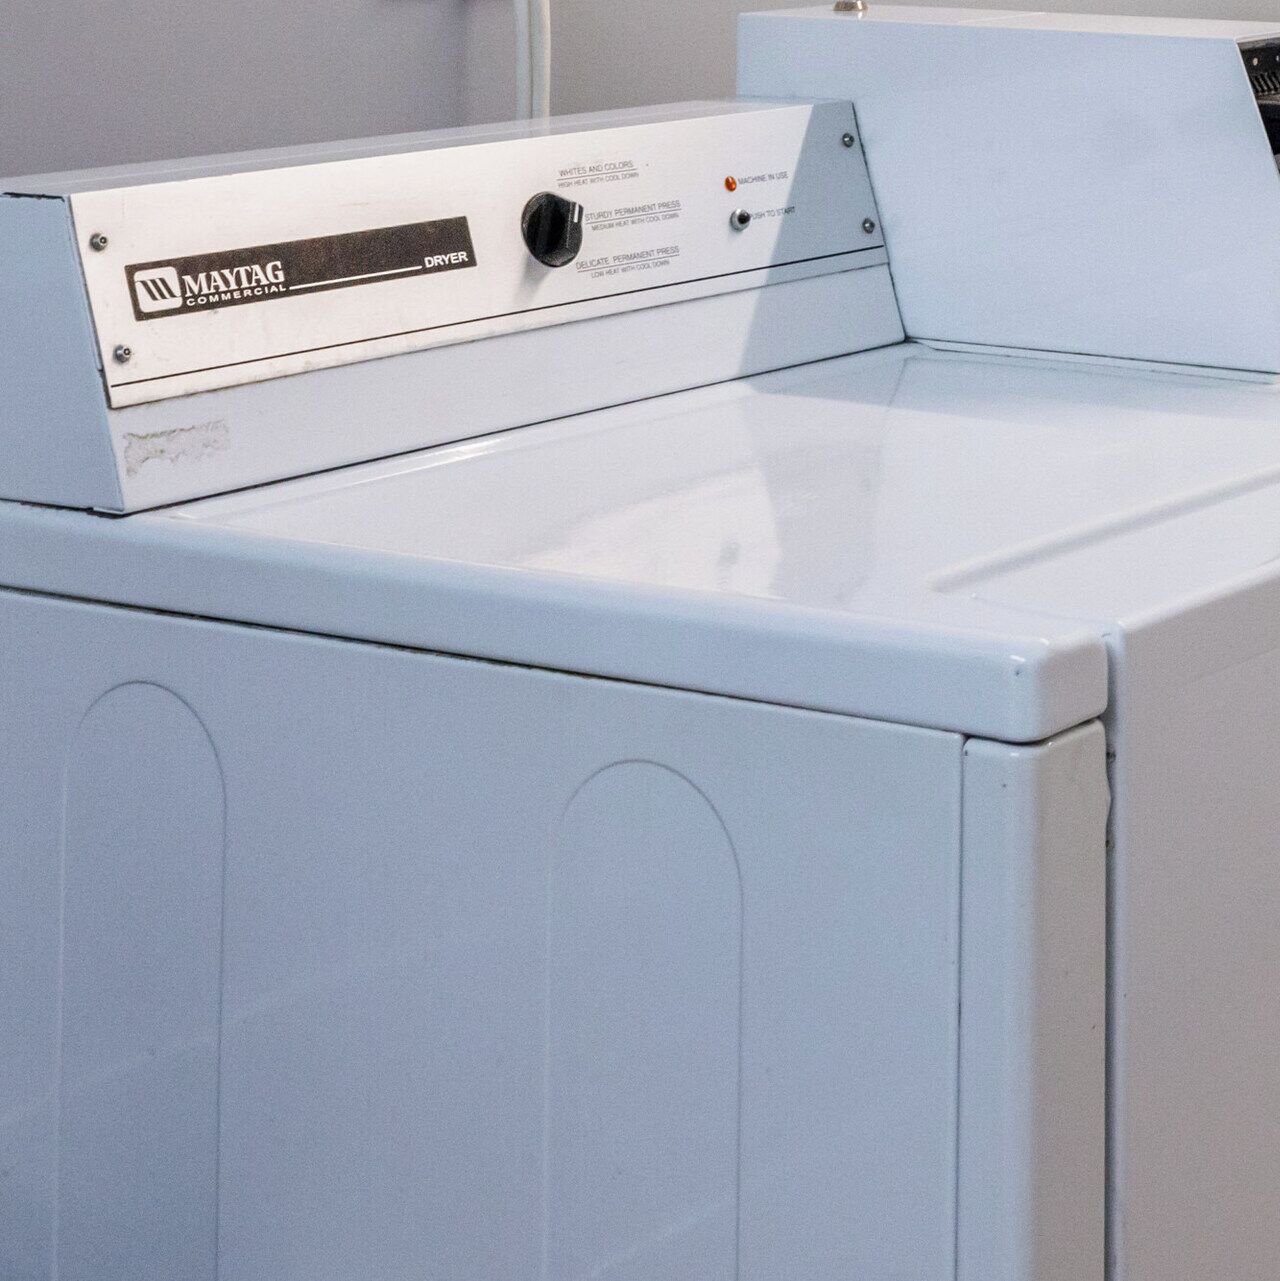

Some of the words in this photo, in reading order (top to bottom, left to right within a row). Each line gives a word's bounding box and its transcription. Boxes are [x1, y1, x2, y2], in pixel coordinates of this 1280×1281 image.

[559, 166, 587, 177] WHITES
[588, 164, 603, 173] AND
[604, 160, 634, 171] COLORS
[737, 173, 766, 185] MACHINE
[768, 172, 775, 181] IN
[775, 171, 788, 180] USE
[584, 210, 613, 221] STURDY
[614, 203, 657, 217] PERMANENT
[657, 199, 682, 209] PRESS
[424, 251, 469, 268] DRYER
[575, 256, 610, 270] DELICATE
[612, 249, 656, 263] PERMANENT
[656, 245, 680, 255] PRESS
[181, 260, 285, 298] MAYTAG
[186, 284, 287, 307] COMMERCIAL
